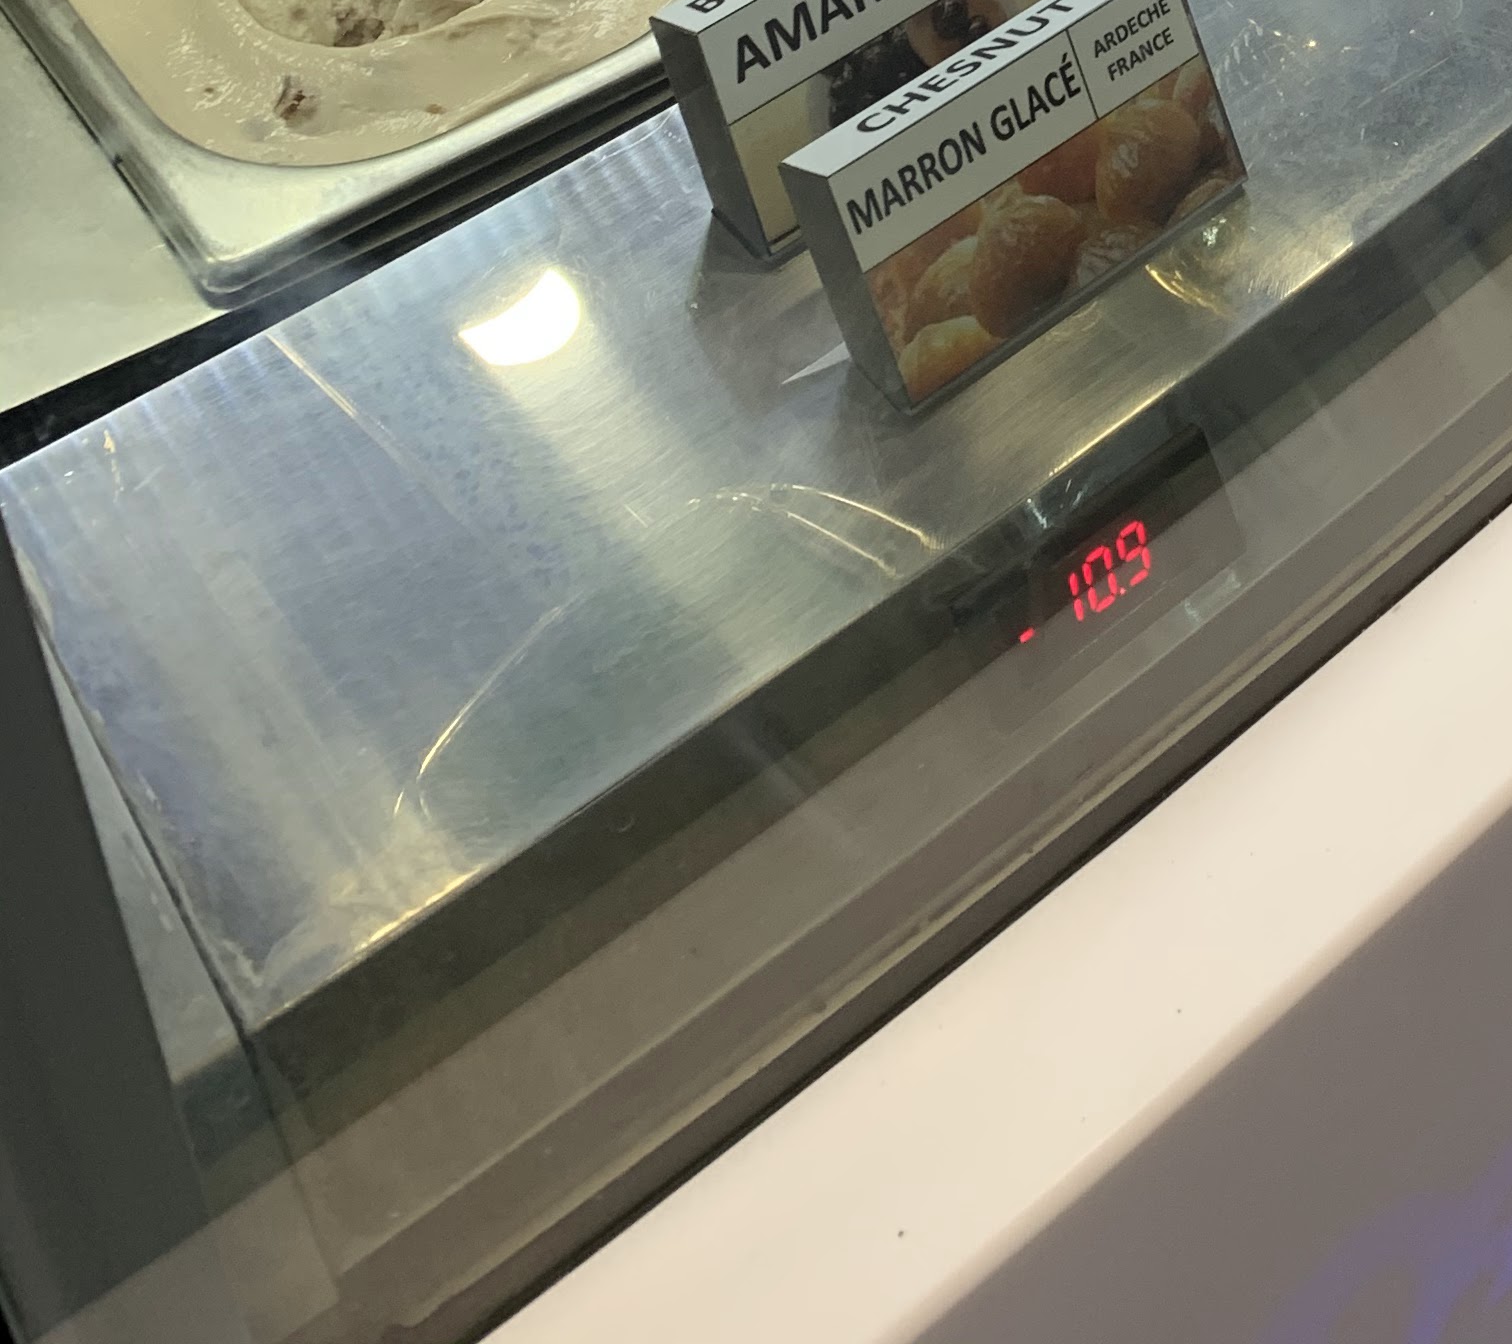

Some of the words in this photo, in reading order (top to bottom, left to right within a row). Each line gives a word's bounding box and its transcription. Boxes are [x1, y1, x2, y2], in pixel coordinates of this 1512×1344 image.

[1107, 26, 1175, 83] FRANCE
[845, 120, 988, 235] MARRON
[989, 53, 1082, 143] GLACÉ
